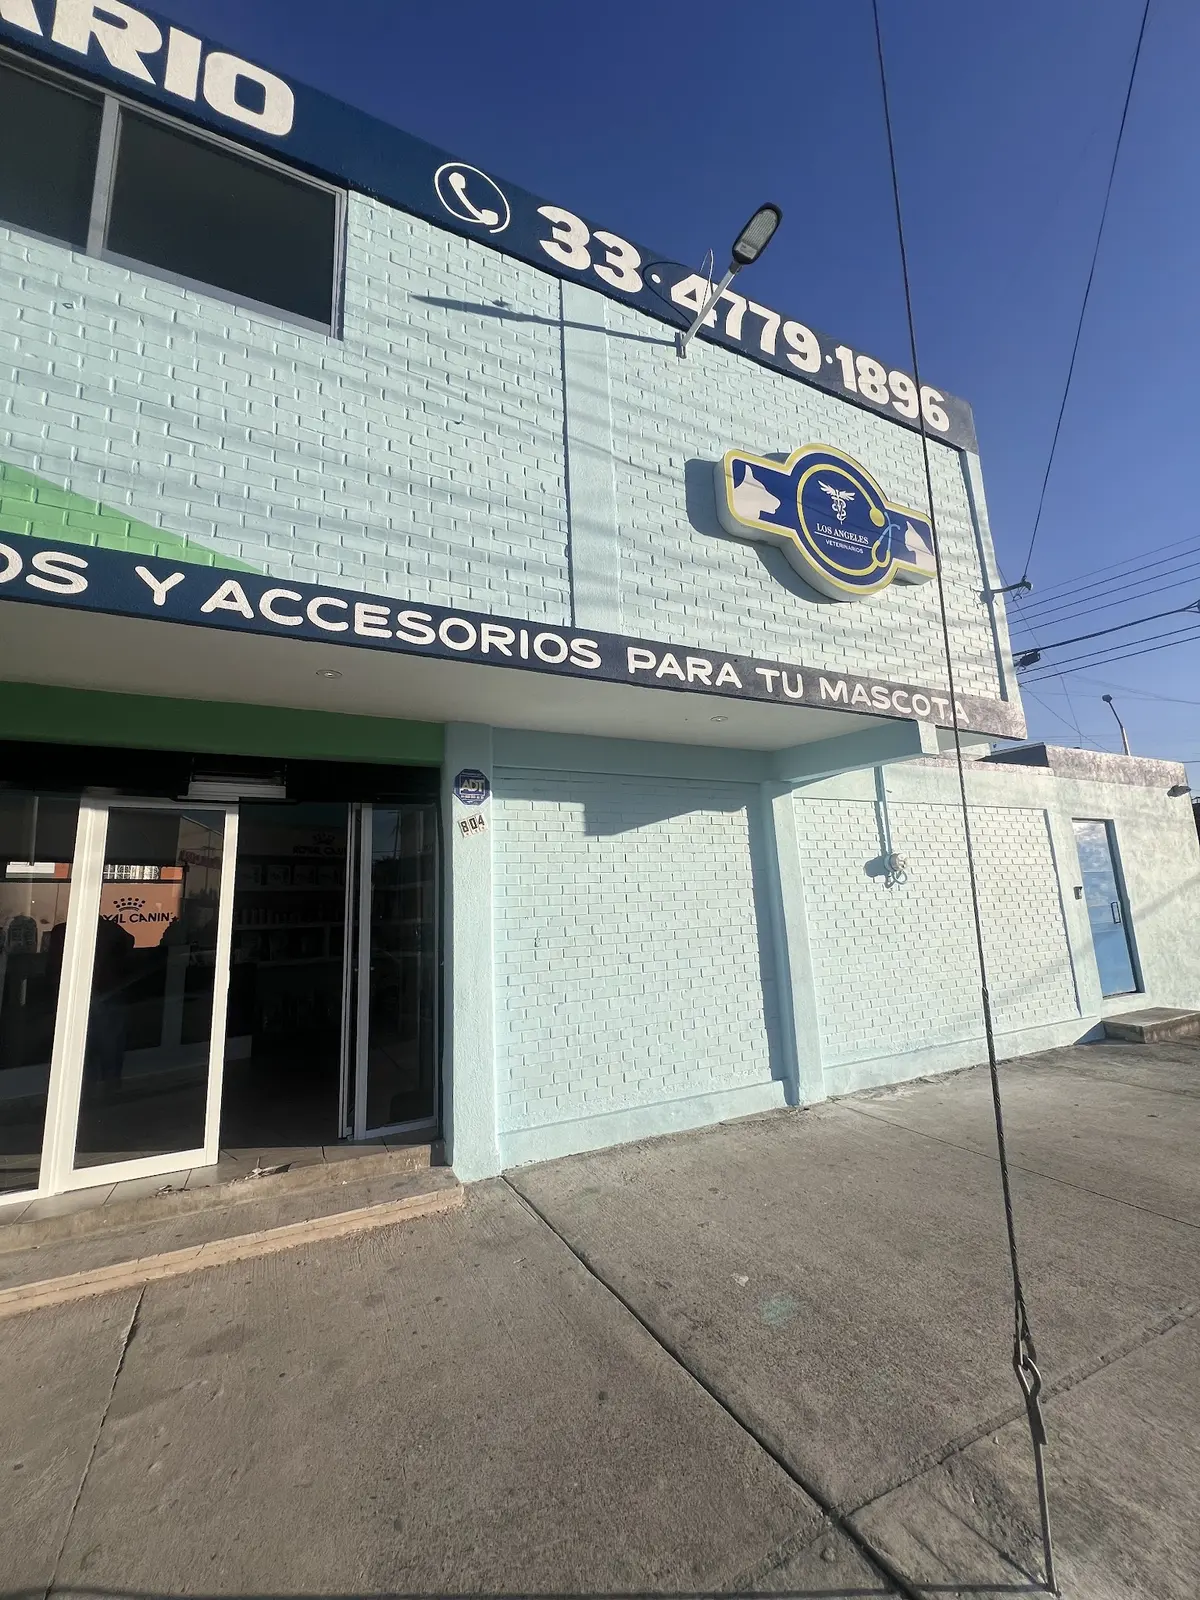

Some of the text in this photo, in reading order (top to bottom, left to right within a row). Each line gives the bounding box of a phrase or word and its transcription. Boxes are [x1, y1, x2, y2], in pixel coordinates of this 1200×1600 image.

[816, 523, 869, 545] LOS ANGELES
[826, 540, 864, 554] VETERINARIOS
[134, 565, 186, 606] Y
[200, 579, 602, 670] ACCESORIOS
[627, 646, 742, 689] PARA
[755, 667, 804, 699] TU
[819, 676, 970, 724] MASCOTA
[461, 779, 485, 792] ADT
[461, 815, 485, 833] 804
[129, 912, 170, 923] CANIN
